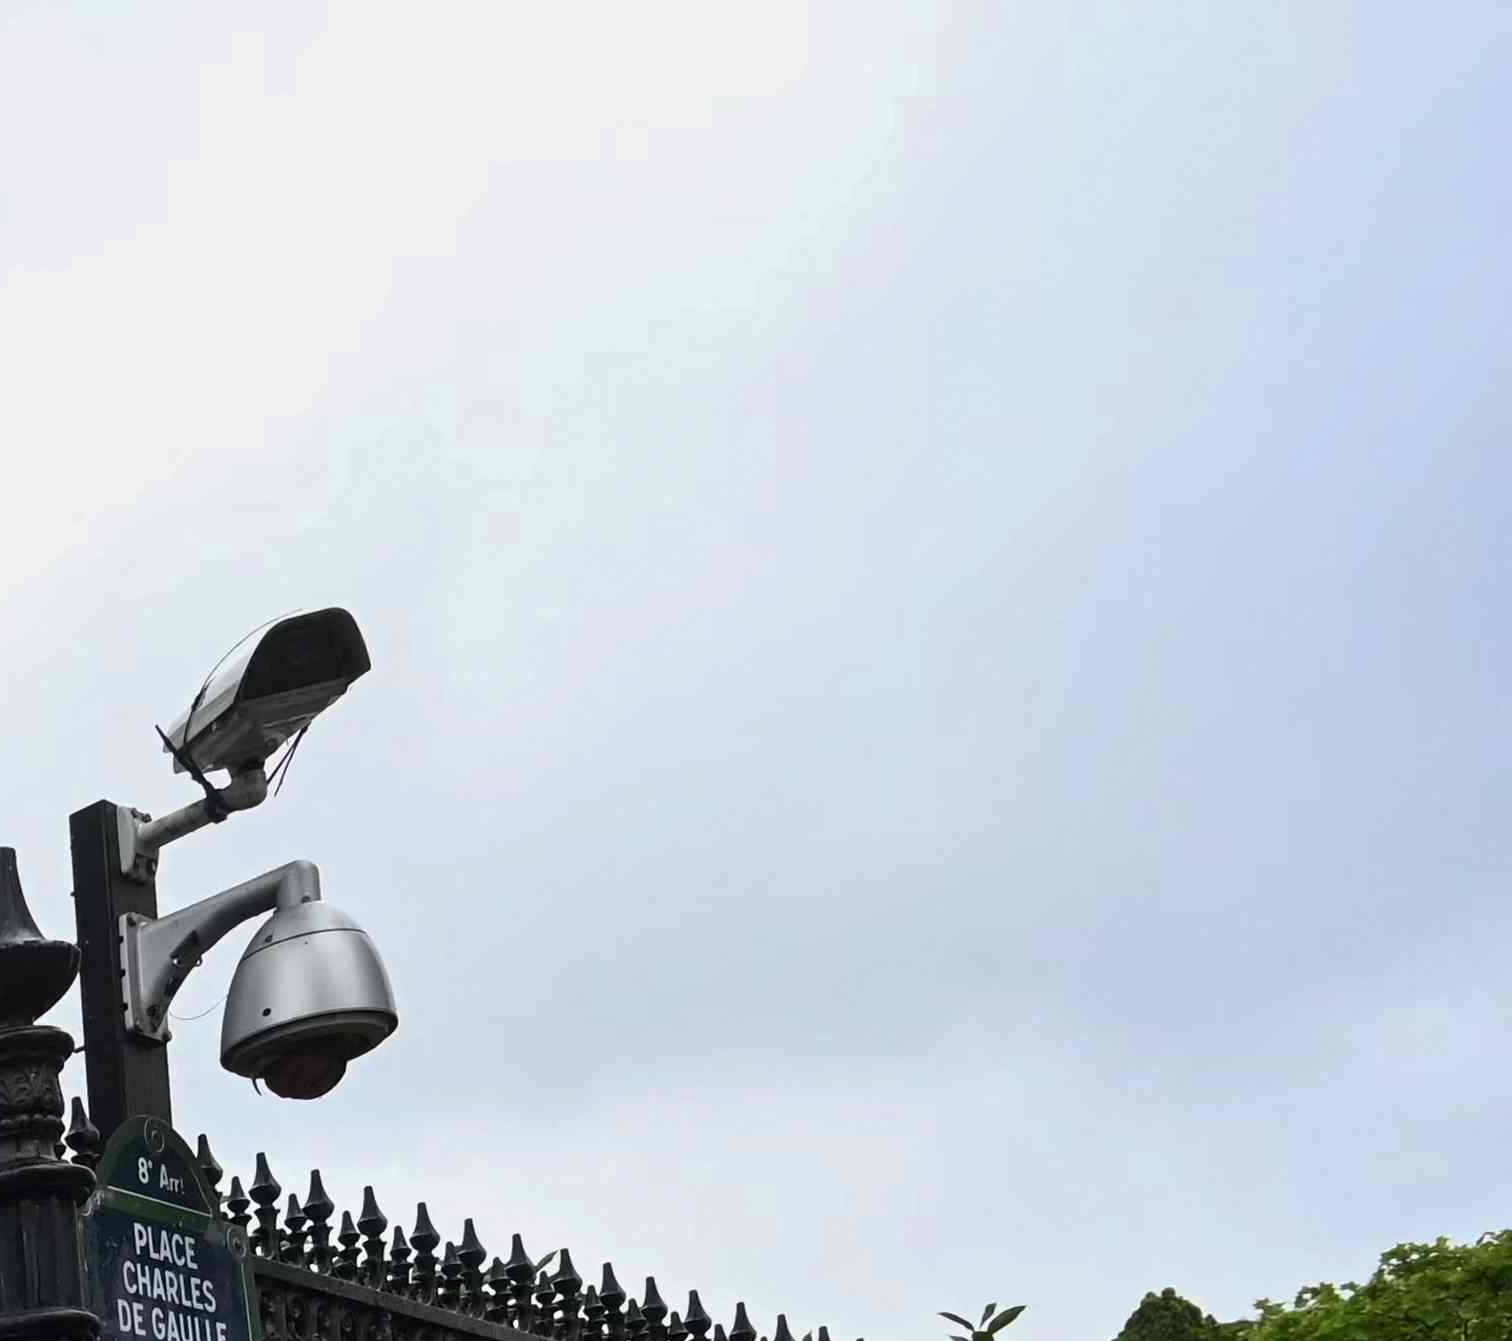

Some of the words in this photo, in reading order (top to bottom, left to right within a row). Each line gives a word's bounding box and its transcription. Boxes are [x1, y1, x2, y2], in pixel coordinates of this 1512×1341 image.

[133, 1222, 198, 1270] PLACE
[123, 1260, 217, 1313] CHARLES
[117, 1299, 147, 1337] DE
